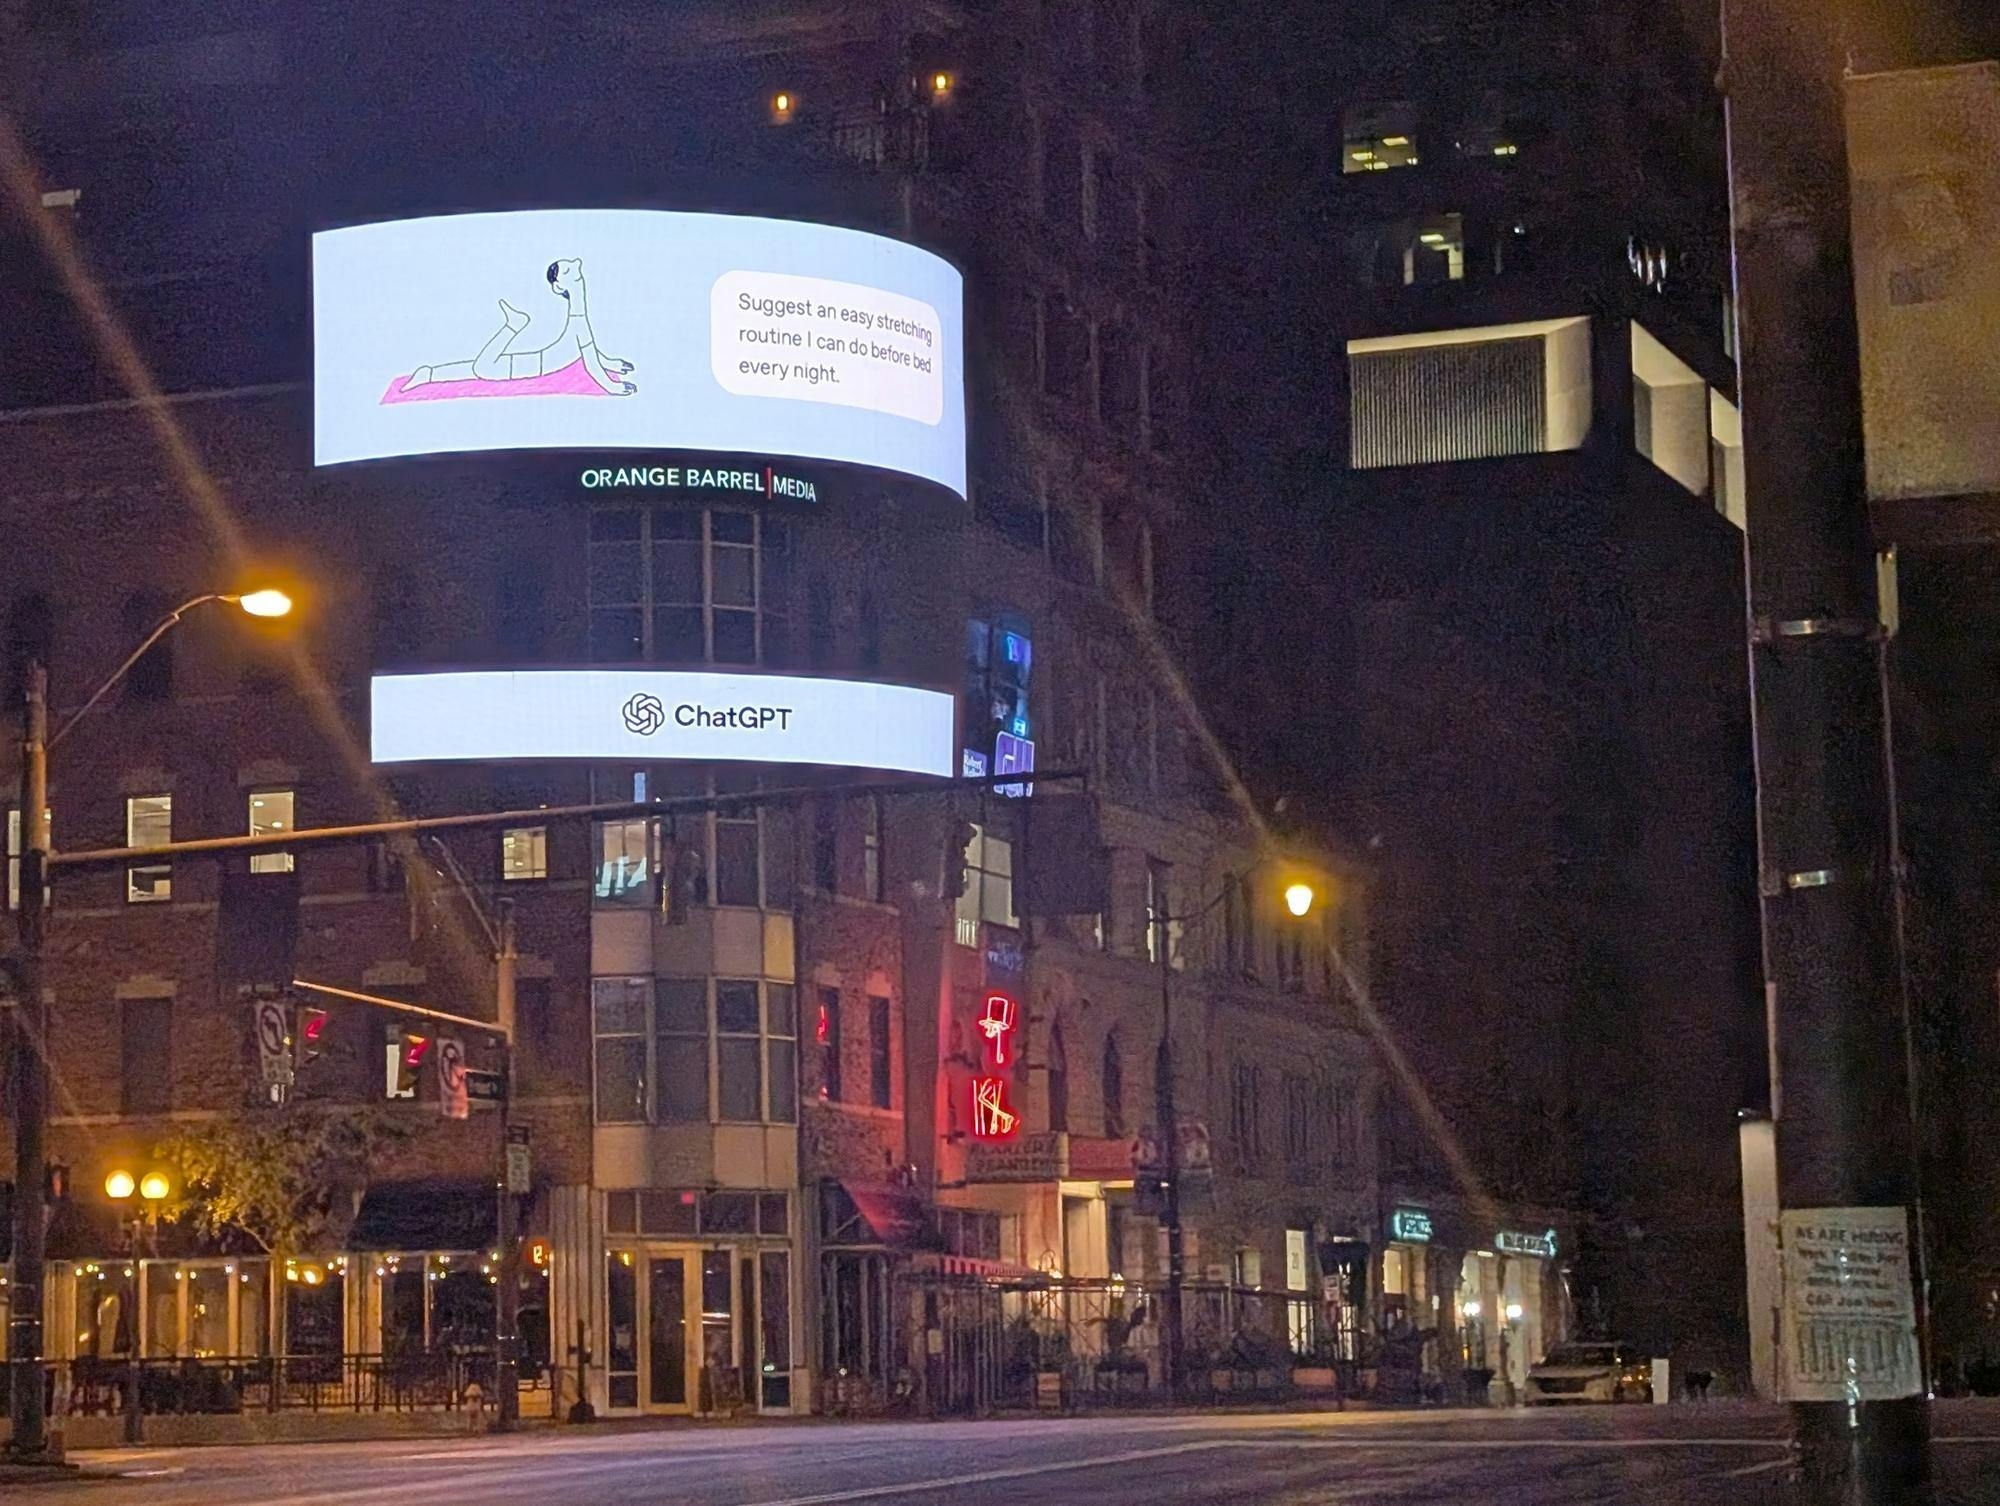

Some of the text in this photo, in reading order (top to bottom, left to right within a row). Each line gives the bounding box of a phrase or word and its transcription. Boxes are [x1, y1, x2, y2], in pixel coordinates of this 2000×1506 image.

[738, 293, 932, 347] Suggest an easy stretching
[739, 327, 932, 373] routine I can do before bed
[739, 360, 840, 384] every night.
[581, 467, 817, 502] ORANGE BARREL MEDIA
[675, 704, 793, 730] ChatGPT
